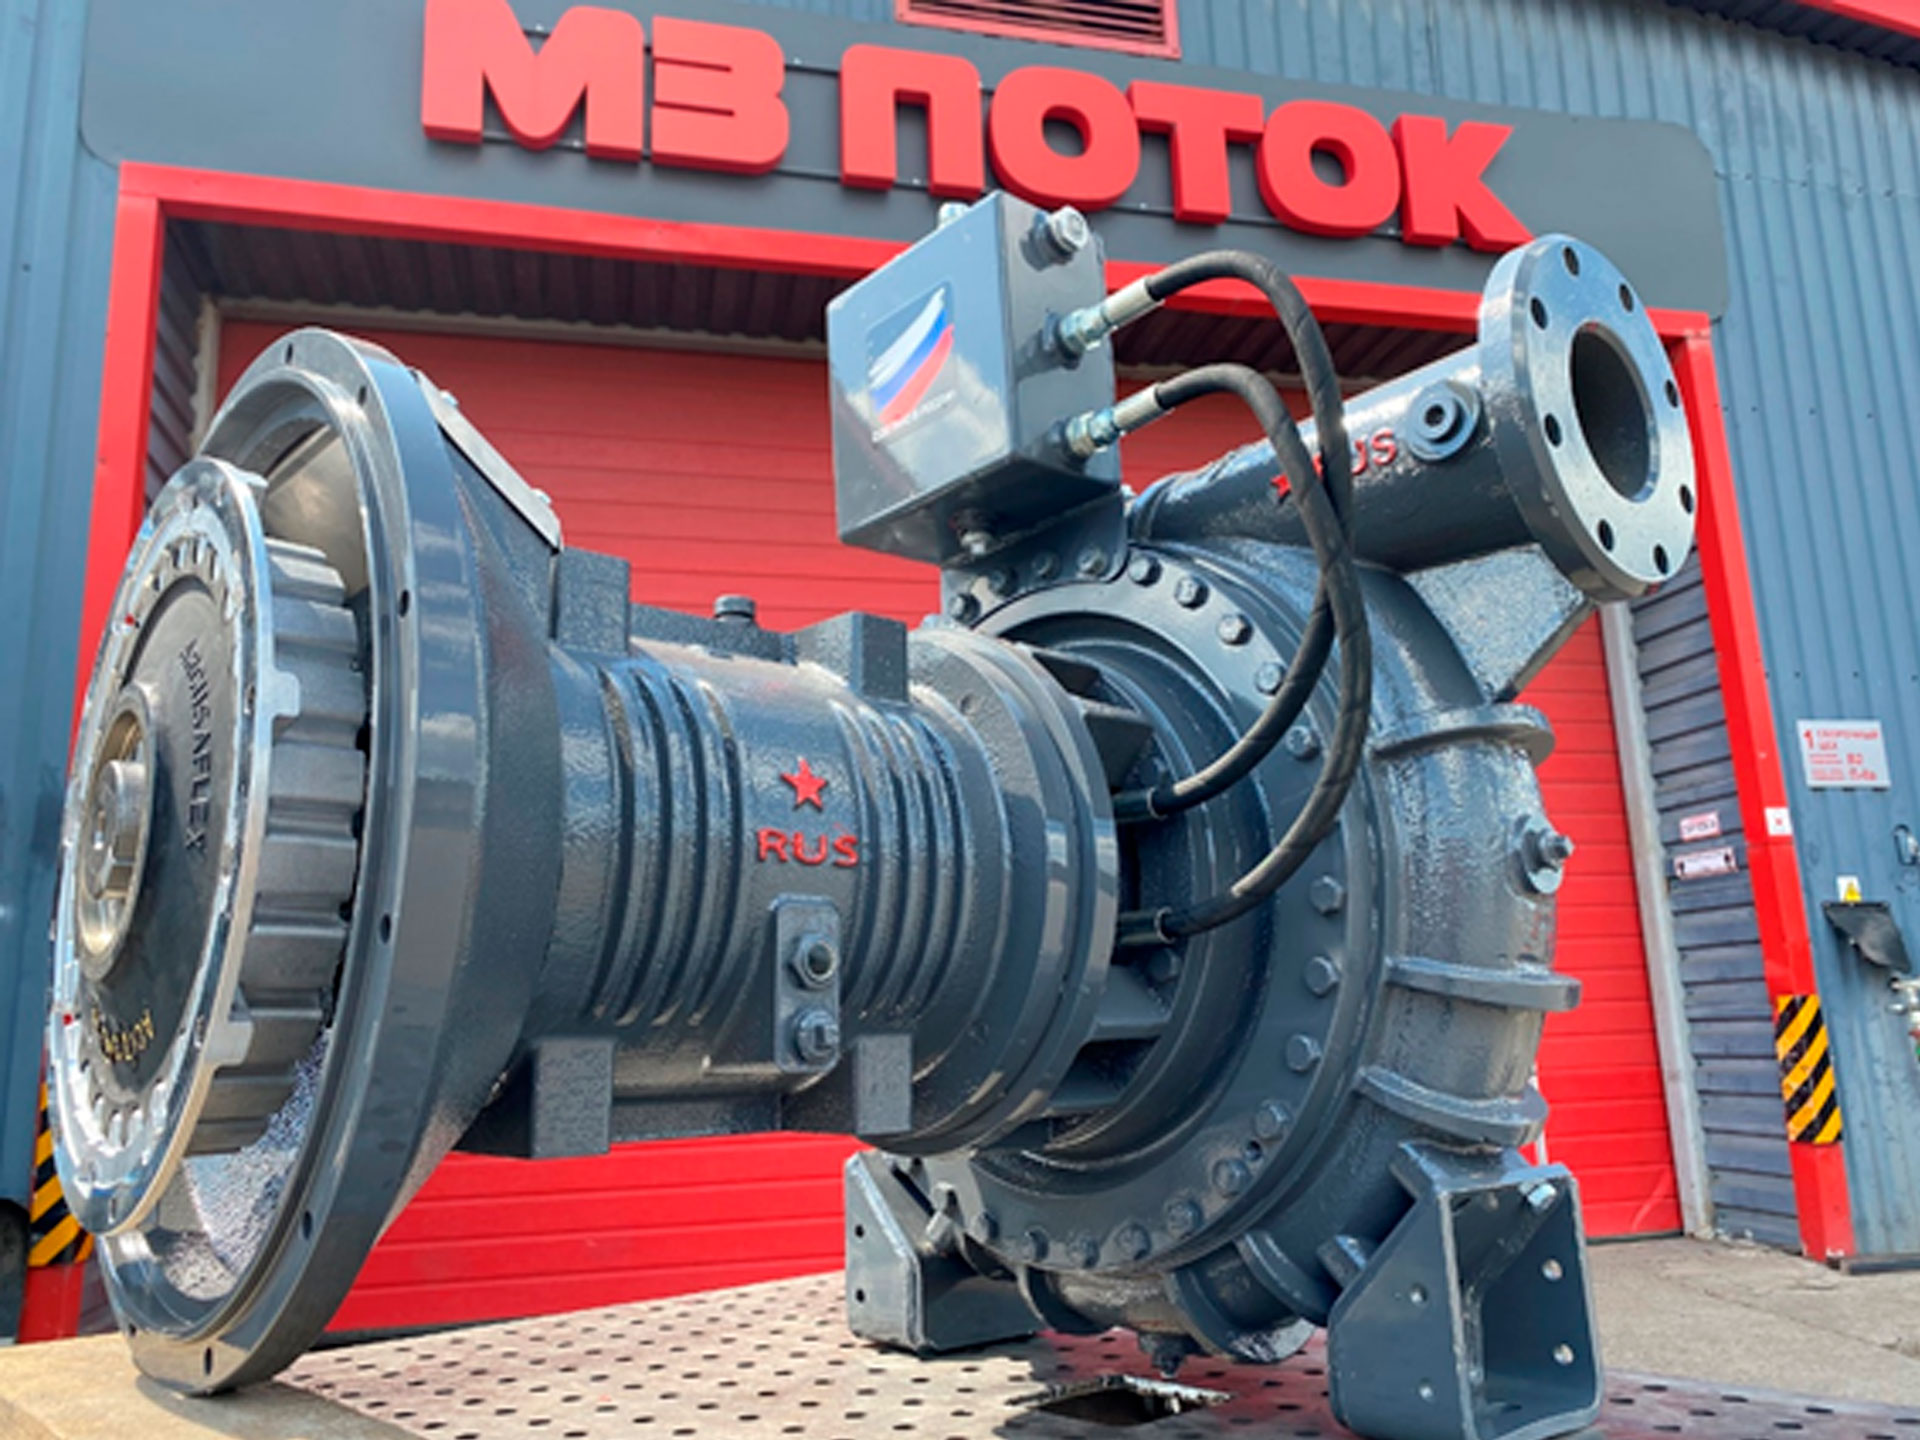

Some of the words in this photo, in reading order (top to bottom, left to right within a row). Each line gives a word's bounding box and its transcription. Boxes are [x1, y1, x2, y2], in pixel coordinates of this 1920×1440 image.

[421, 0, 790, 177] МЗ
[838, 42, 1535, 253] ПОТОК
[1803, 729, 1814, 750] 1
[756, 827, 859, 868] RUS
